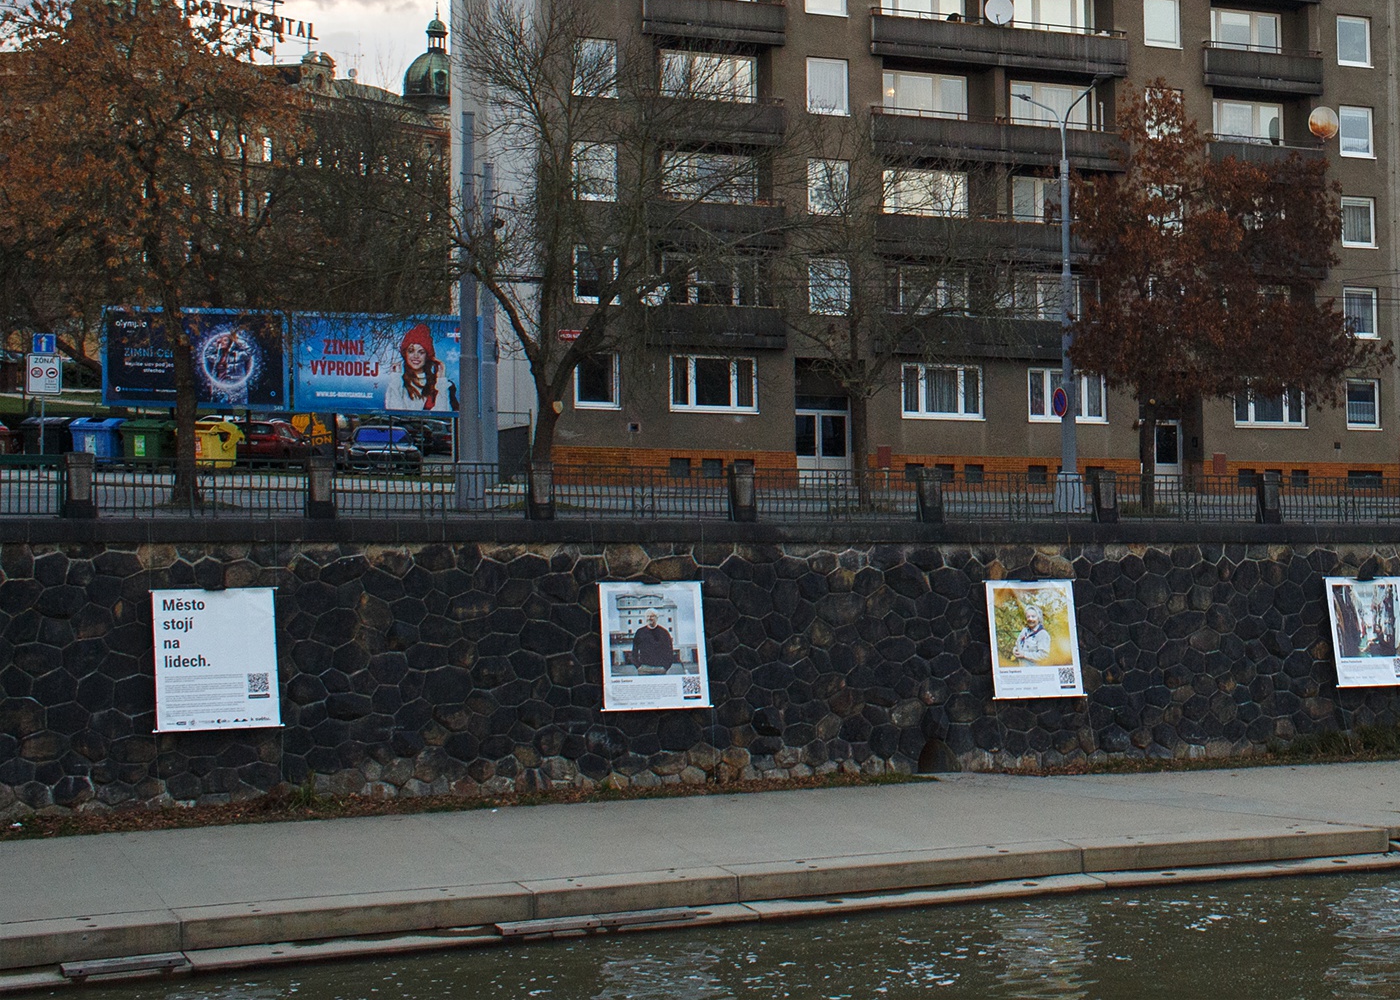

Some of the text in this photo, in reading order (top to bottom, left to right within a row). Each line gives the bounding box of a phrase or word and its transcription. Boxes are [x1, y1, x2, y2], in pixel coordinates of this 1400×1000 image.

[323, 336, 365, 355] ZIMNÍ
[310, 356, 380, 377] VÝPRODEJ
[162, 598, 206, 611] Město
[163, 617, 194, 633] stojí
[163, 639, 180, 649] na
[164, 654, 211, 668] lidech.
